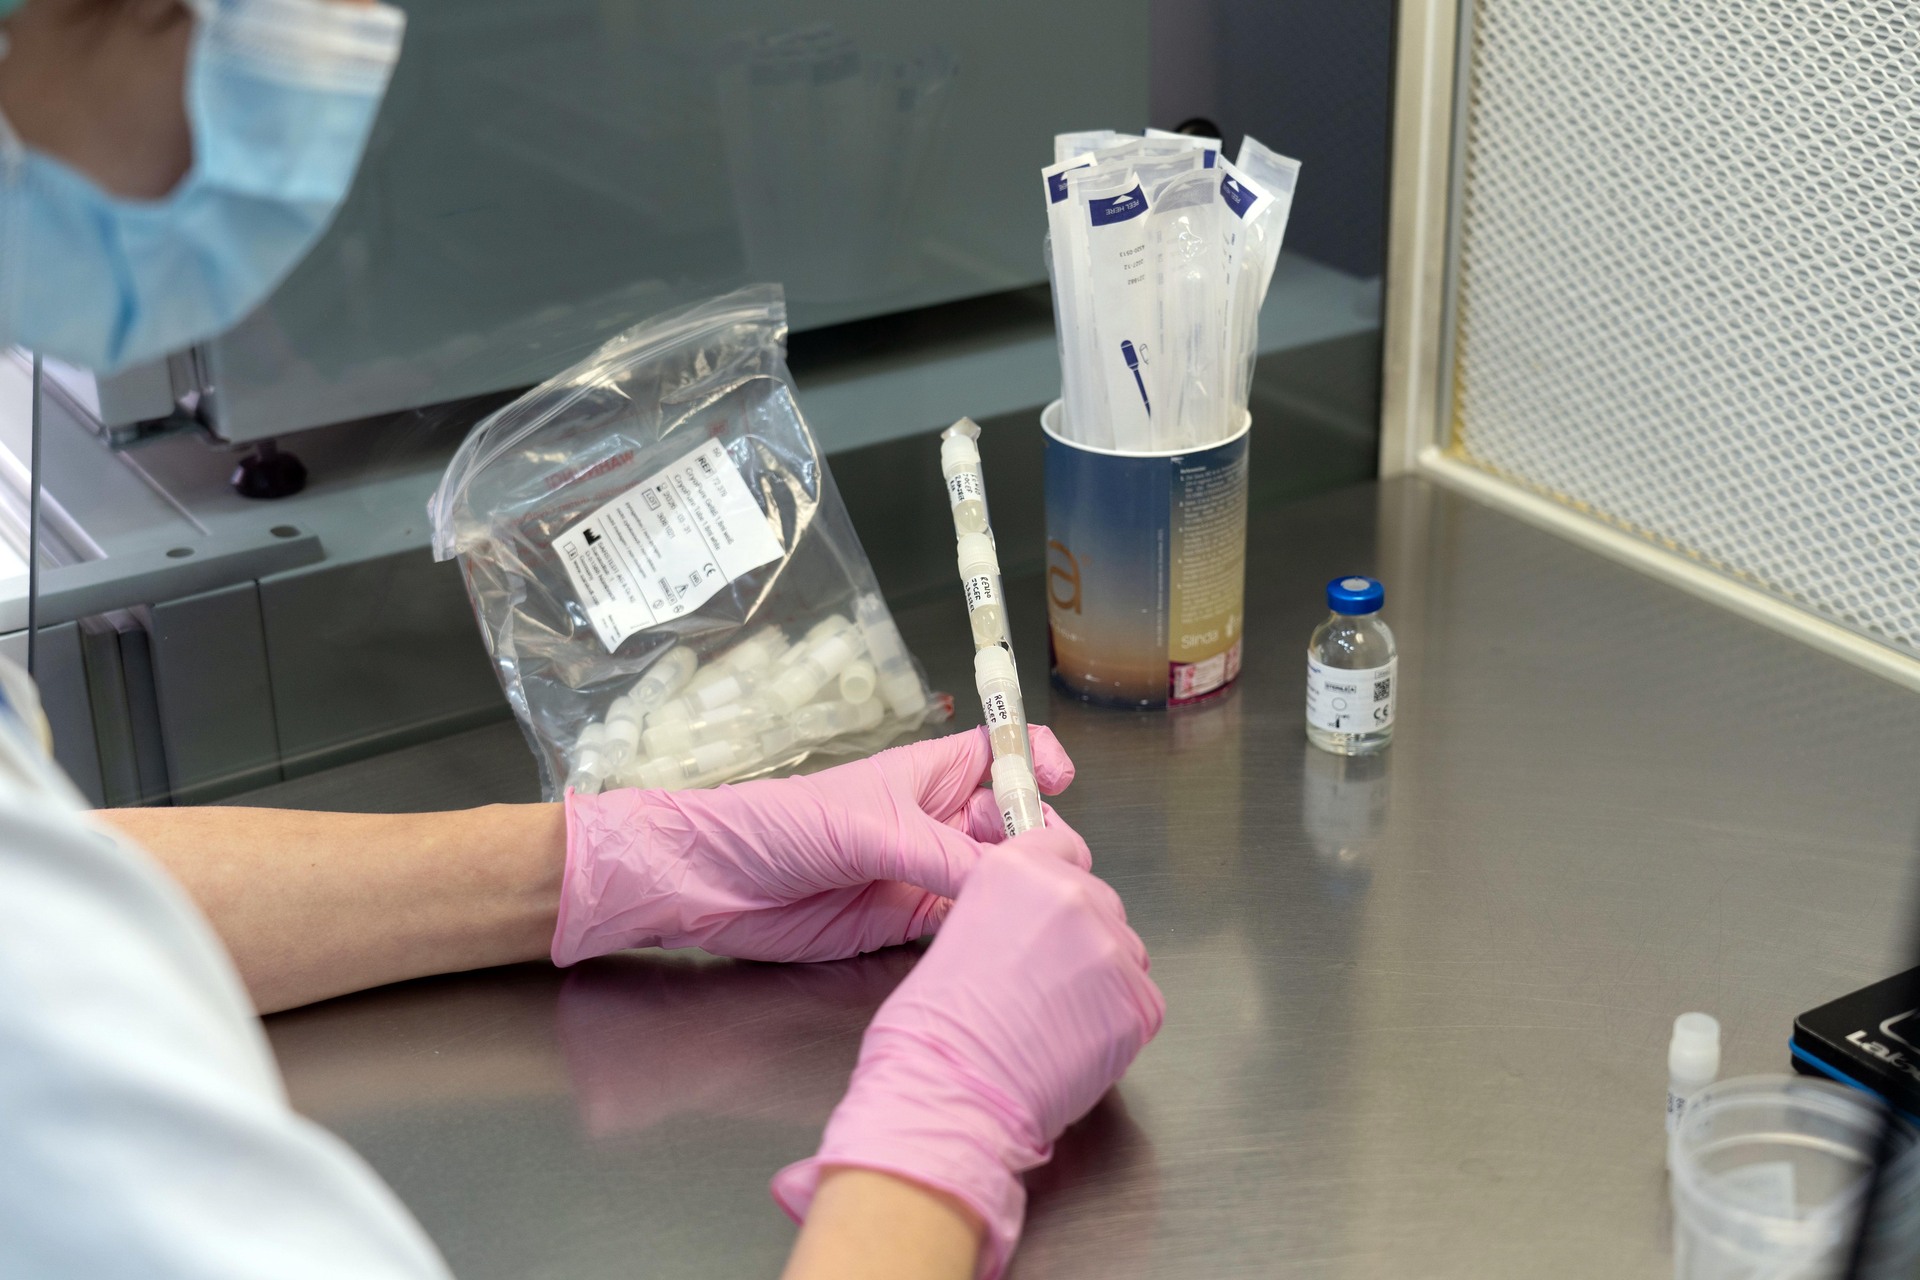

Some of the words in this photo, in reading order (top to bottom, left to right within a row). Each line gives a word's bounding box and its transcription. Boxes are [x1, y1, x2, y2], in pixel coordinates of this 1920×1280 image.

[1105, 205, 1124, 215] HERE
[1125, 199, 1139, 209] PEEL
[698, 457, 711, 472] REF
[673, 473, 694, 505] CryoPure
[684, 466, 706, 498] CryoPure
[646, 493, 658, 507] LOT
[994, 694, 1007, 719] RENZO
